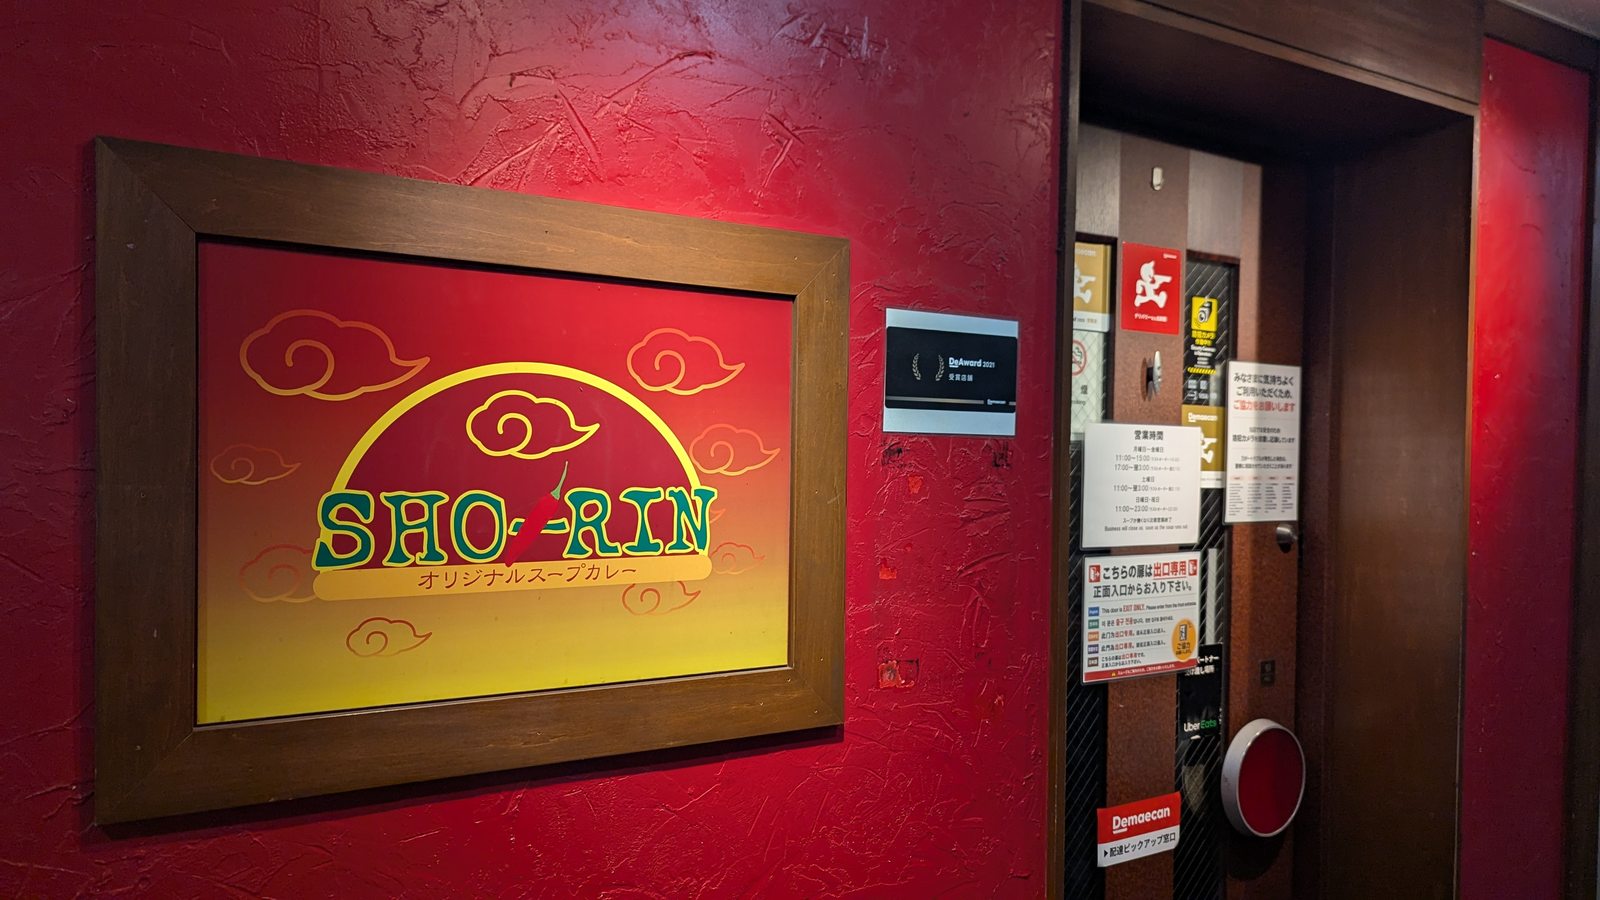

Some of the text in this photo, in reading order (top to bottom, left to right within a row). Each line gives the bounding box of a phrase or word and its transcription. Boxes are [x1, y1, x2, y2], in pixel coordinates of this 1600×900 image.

[948, 357, 982, 368] DeAward
[1234, 373, 1294, 386] みなさまに気持ちよく
[1134, 430, 1164, 440] 営業時間
[418, 562, 637, 590] オリジナルスープカレー
[1102, 561, 1187, 580] こちらの扉は出口専用
[1093, 580, 1192, 598] 正面入口からお入り下さい。
[1184, 720, 1216, 732] Uber Eats
[1112, 807, 1170, 832] Demaecan
[1109, 832, 1176, 858] 配達ピックアップ窓口
